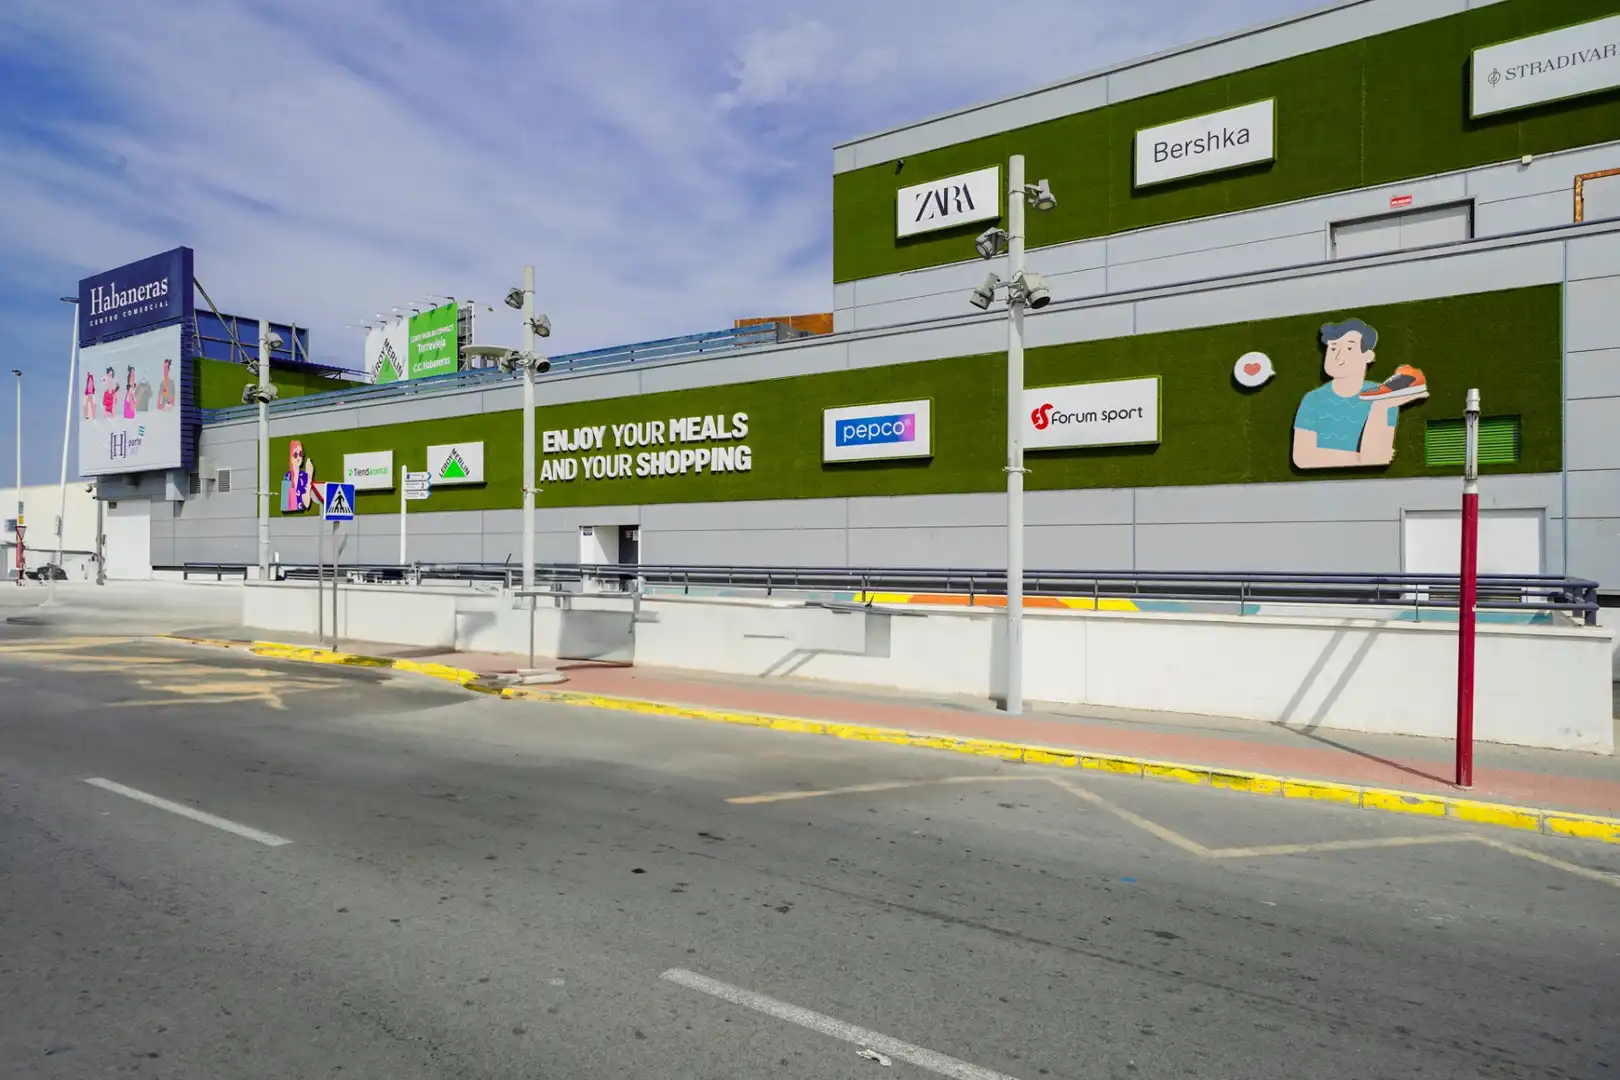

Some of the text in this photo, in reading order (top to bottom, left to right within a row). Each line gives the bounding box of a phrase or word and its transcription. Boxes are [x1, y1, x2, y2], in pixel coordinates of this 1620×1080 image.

[1154, 127, 1250, 163] Bershka
[915, 183, 975, 222] ZARA
[89, 300, 169, 327] CENTRO COMERCIAL
[90, 277, 168, 316] Habaneras
[383, 337, 403, 377] MERLIN
[542, 412, 749, 453] ENJOY YOUR MEALS
[843, 421, 905, 442] pepco
[1101, 406, 1143, 423] sport
[438, 447, 471, 478] LEROY MERLIN
[540, 445, 752, 482] AND YOUR SHOPPING
